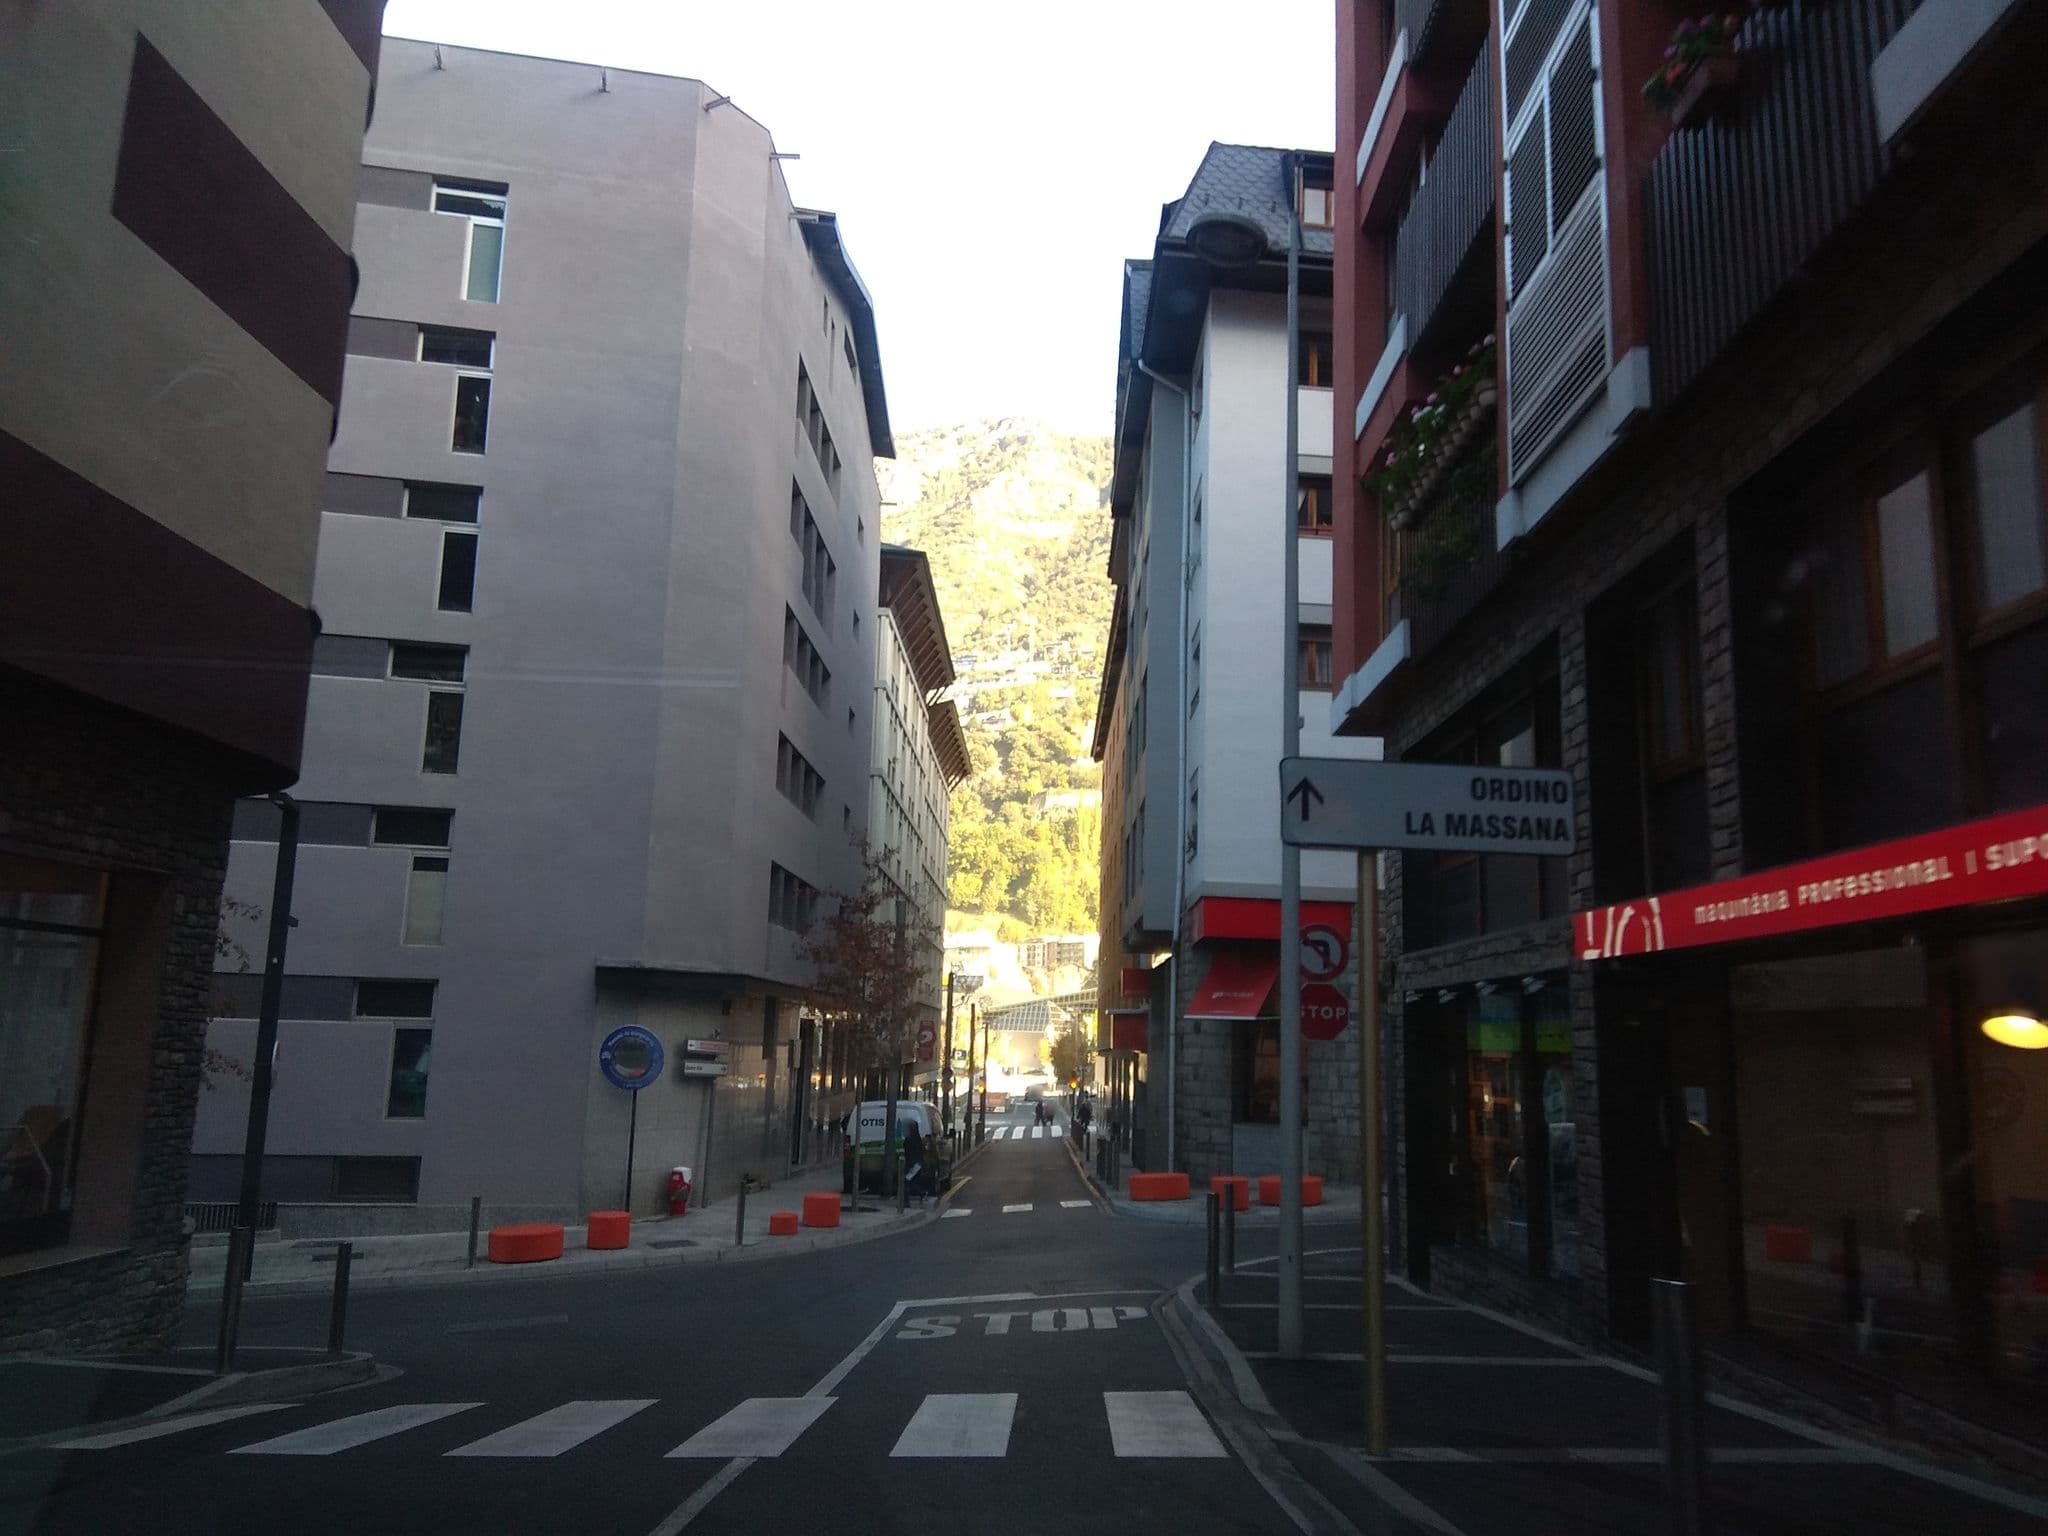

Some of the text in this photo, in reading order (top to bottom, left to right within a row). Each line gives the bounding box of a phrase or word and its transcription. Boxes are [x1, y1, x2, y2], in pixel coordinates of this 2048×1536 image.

[1471, 777, 1568, 804] ORDINO
[1405, 811, 1570, 841] LA MASSANA
[862, 1118, 885, 1127] OTIS
[896, 1305, 1148, 1339] STOP
